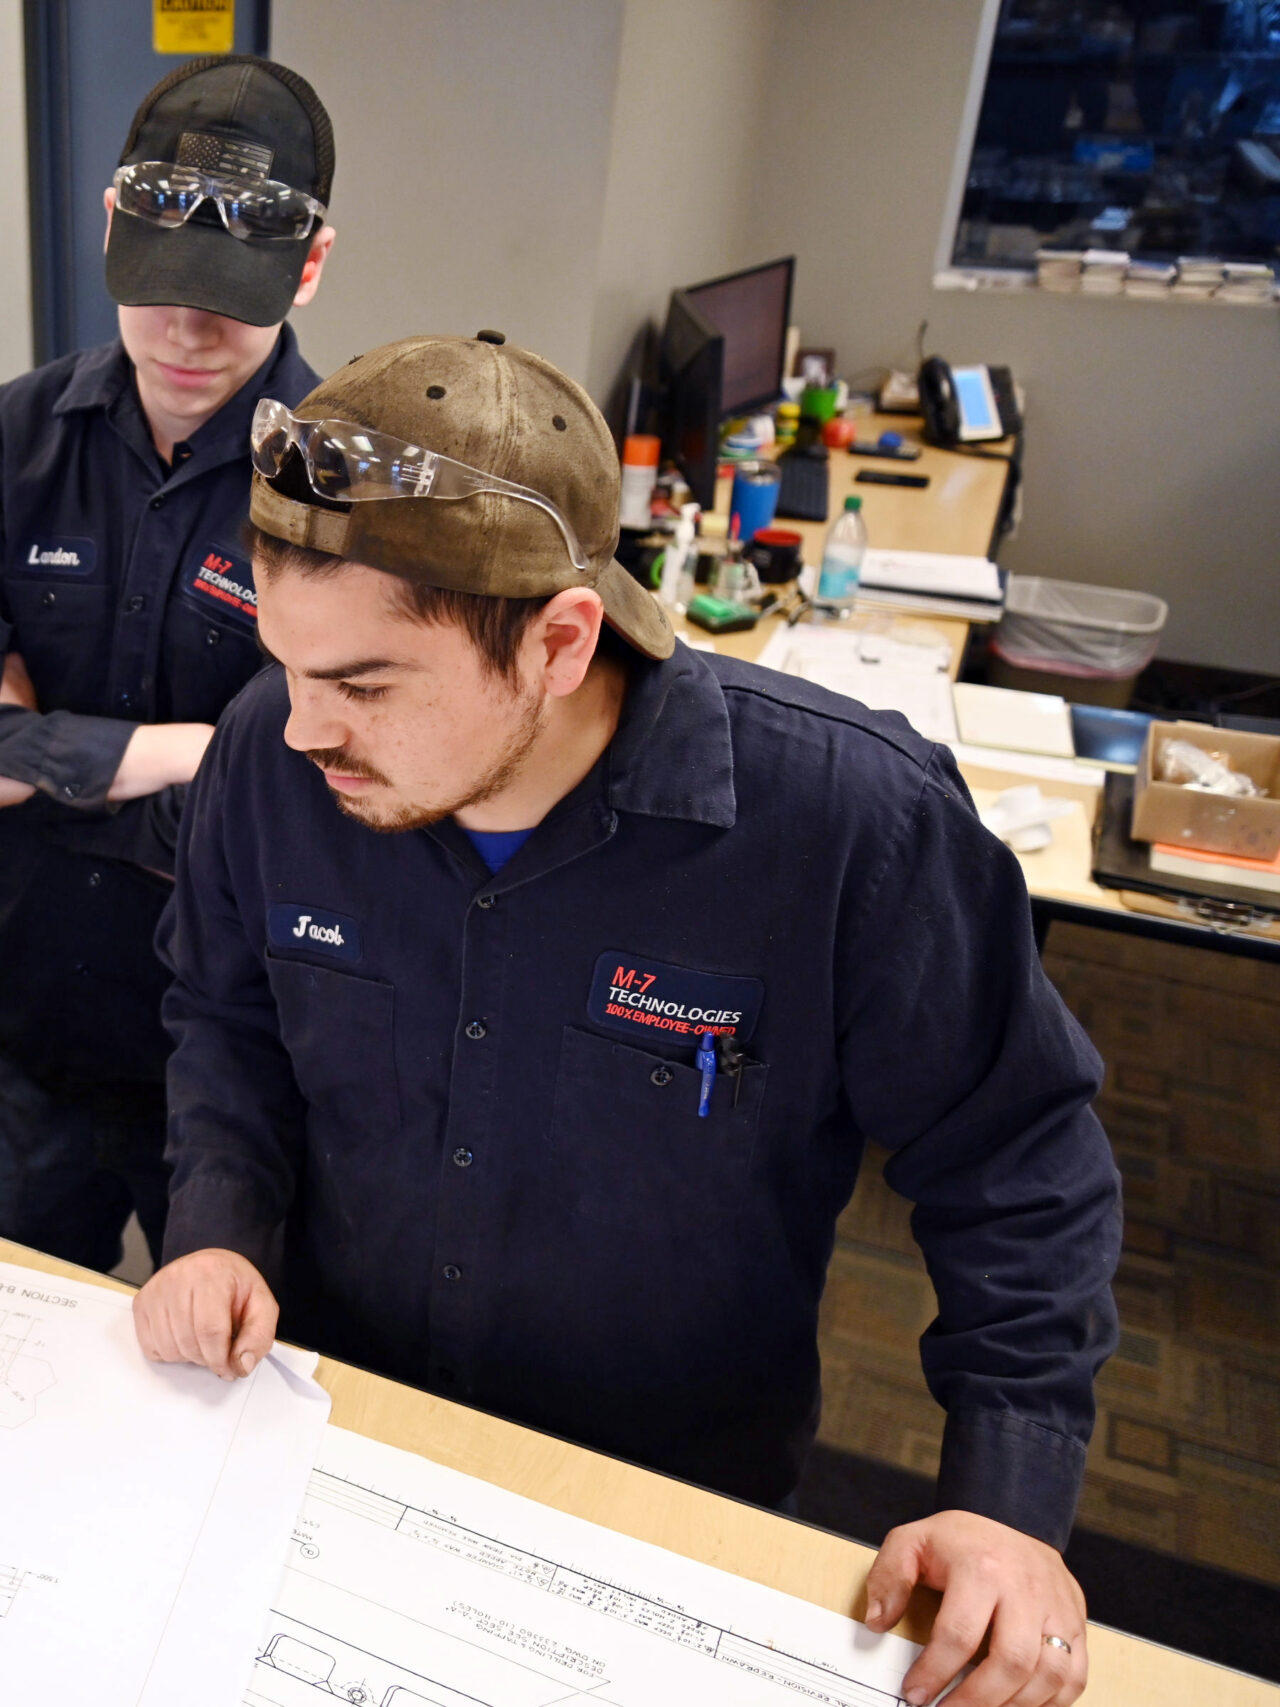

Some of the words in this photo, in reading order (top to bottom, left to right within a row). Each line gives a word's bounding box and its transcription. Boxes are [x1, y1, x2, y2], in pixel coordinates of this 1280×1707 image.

[203, 553, 233, 575] M-7
[198, 566, 258, 608] TECHNOLOG
[293, 915, 345, 947] Jacob
[612, 966, 657, 993] M-7
[609, 986, 742, 1024] TECHNOLOGIES
